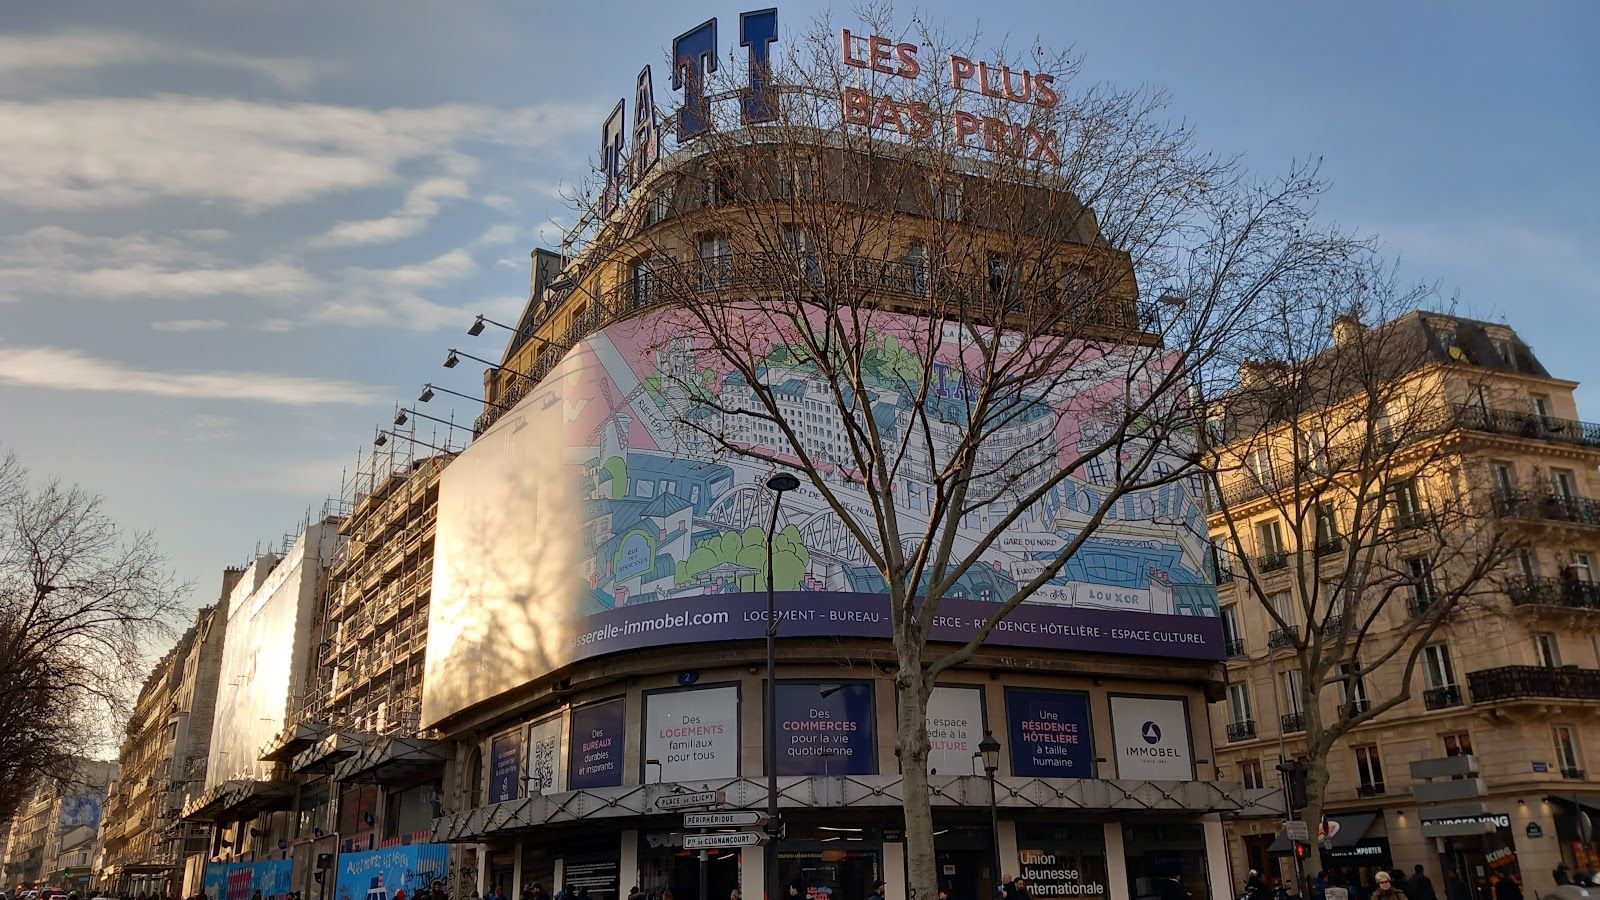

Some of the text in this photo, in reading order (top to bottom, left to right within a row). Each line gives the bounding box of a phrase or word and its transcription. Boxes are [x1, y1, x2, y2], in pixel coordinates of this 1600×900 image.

[841, 28, 1058, 109] LES PLUS
[843, 86, 1062, 167] BAS PRIX
[1003, 539, 1023, 547] GARE
[1036, 539, 1057, 547] NORD
[1088, 589, 1140, 604] LOUXOR
[829, 610, 880, 623] BUREAU
[974, 617, 1038, 634] RÉIDENCE
[1039, 621, 1101, 638] HÔTELIÈRE
[1111, 628, 1151, 641] ESPACE
[1152, 630, 1206, 644] CULTUREL
[809, 708, 830, 719] Des
[1039, 710, 1059, 720] Une
[682, 715, 701, 725] Des
[783, 721, 857, 731] COMMERCES
[933, 718, 968, 728] espace
[1021, 719, 1078, 733] RÉSIDENCE
[591, 729, 604, 739] Des
[659, 724, 725, 739] LOGEMENTS
[958, 729, 967, 739] la
[1023, 730, 1079, 744] HÔTELIÈRE
[582, 737, 613, 753] BUREAUX
[669, 739, 713, 751] familiaux
[791, 733, 849, 745] pour la vie
[787, 745, 854, 757] quotidienne
[930, 740, 968, 751] ULTURE
[1044, 744, 1068, 755] taille
[584, 751, 610, 763] durables
[667, 751, 715, 764] pour tous
[1126, 747, 1181, 758] IMMOBEL
[1032, 755, 1073, 767] humaine
[586, 762, 614, 775] inspirants
[661, 797, 680, 806] PLACE
[691, 793, 714, 802] CLICHY
[687, 815, 734, 824] PÉRIPHÉRIQUE
[704, 835, 750, 845] CLIGNANCOURT
[1020, 851, 1056, 865] Union
[1021, 867, 1079, 880] Jeunesse
[1025, 880, 1104, 896] nternationale
